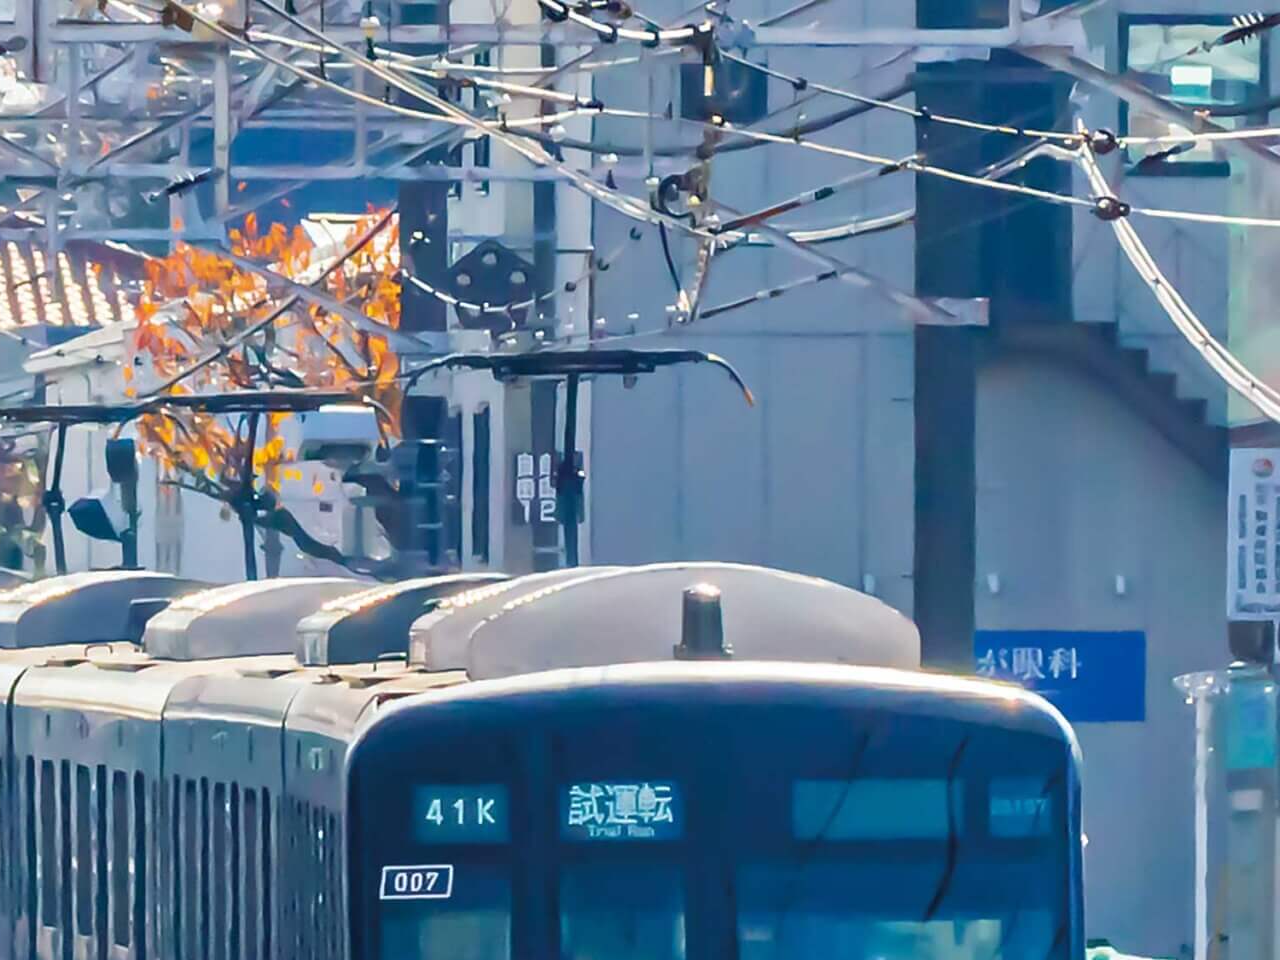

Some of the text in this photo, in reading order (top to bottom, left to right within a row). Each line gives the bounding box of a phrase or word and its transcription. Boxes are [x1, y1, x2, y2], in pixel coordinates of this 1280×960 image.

[426, 797, 496, 825] 41K
[568, 782, 674, 825] 試運転
[394, 872, 439, 893] 007
